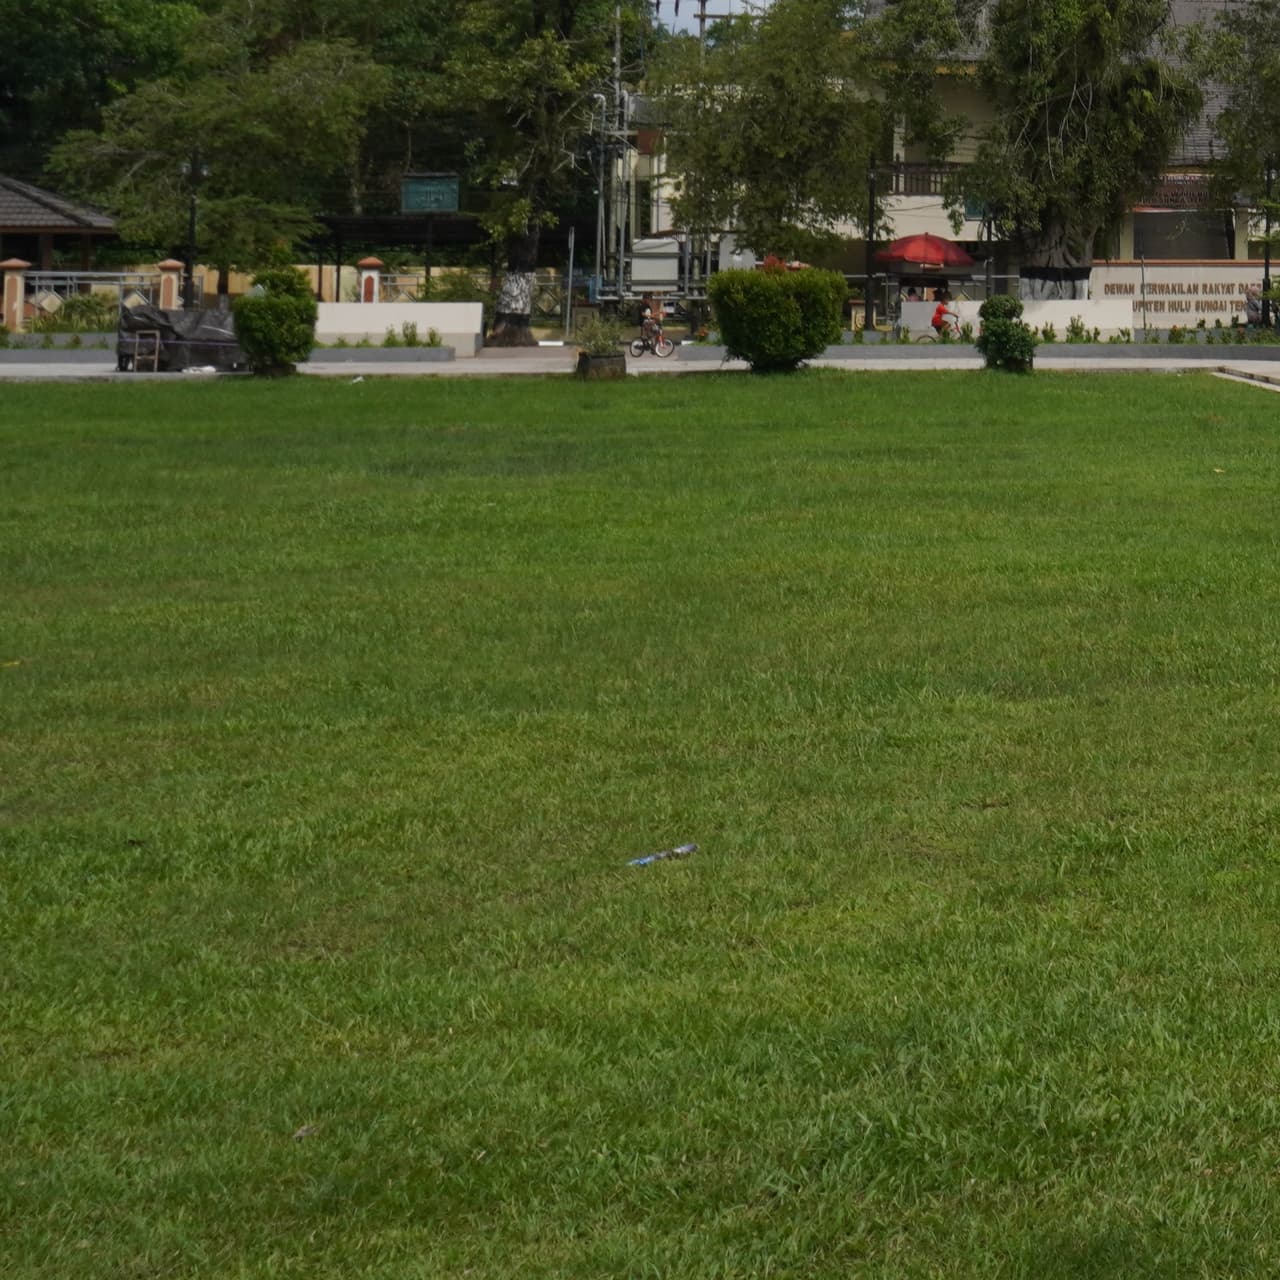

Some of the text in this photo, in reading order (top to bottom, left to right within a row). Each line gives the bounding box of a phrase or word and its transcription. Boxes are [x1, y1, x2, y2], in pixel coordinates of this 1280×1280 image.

[1104, 283, 1135, 295] DEWAN
[1140, 283, 1199, 295] PERWAKILAN
[1201, 283, 1235, 295] RAKYAT
[1168, 300, 1191, 312] HULU
